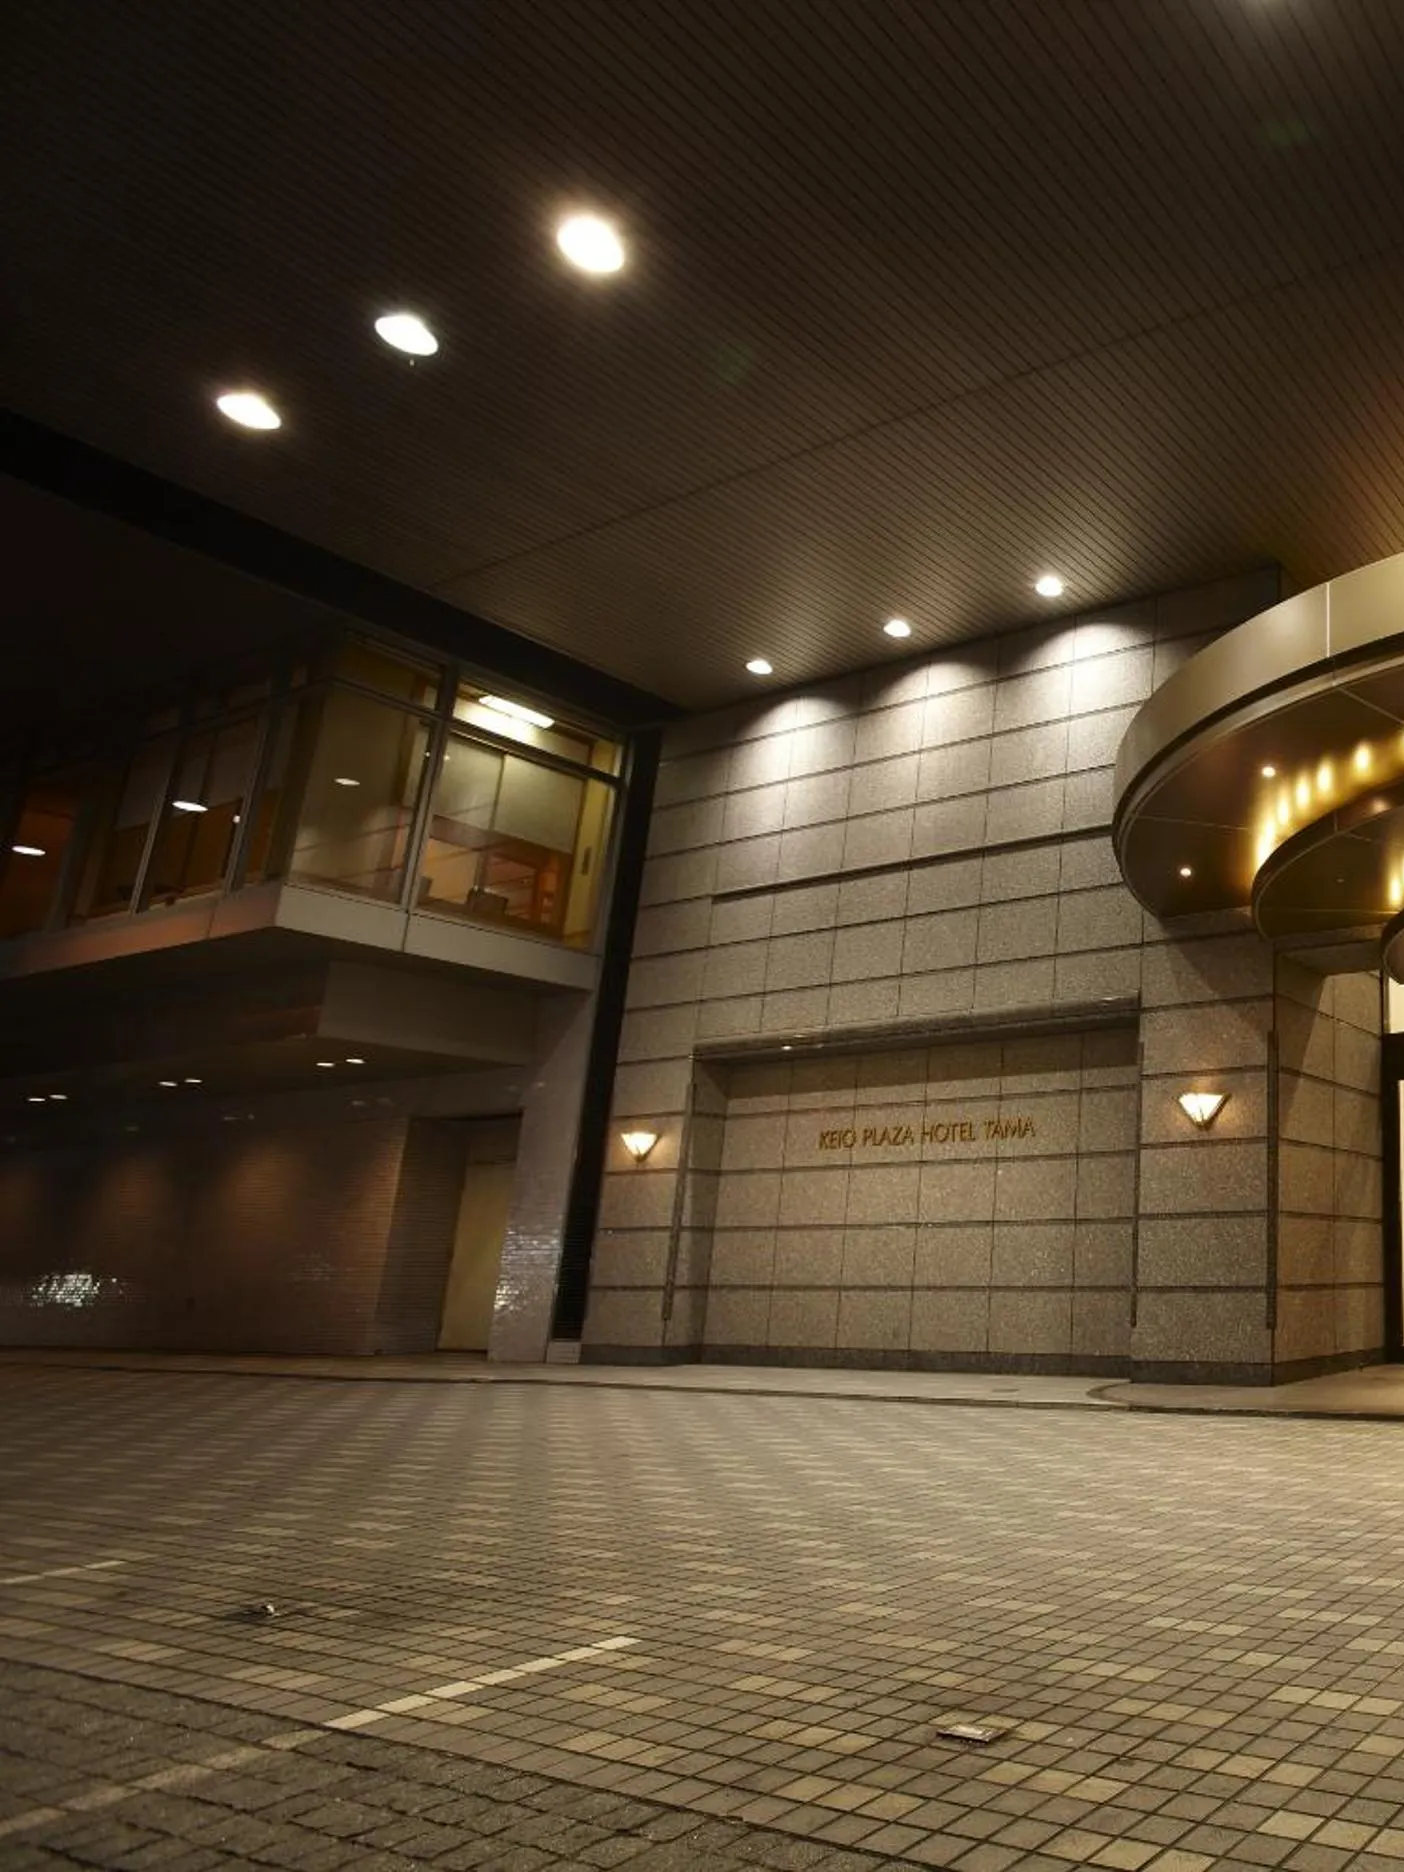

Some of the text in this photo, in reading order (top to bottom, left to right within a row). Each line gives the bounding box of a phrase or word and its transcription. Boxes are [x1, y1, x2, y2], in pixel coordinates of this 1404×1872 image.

[819, 1117, 1036, 1149] KEIO PLAZA HOTEL TAMA
